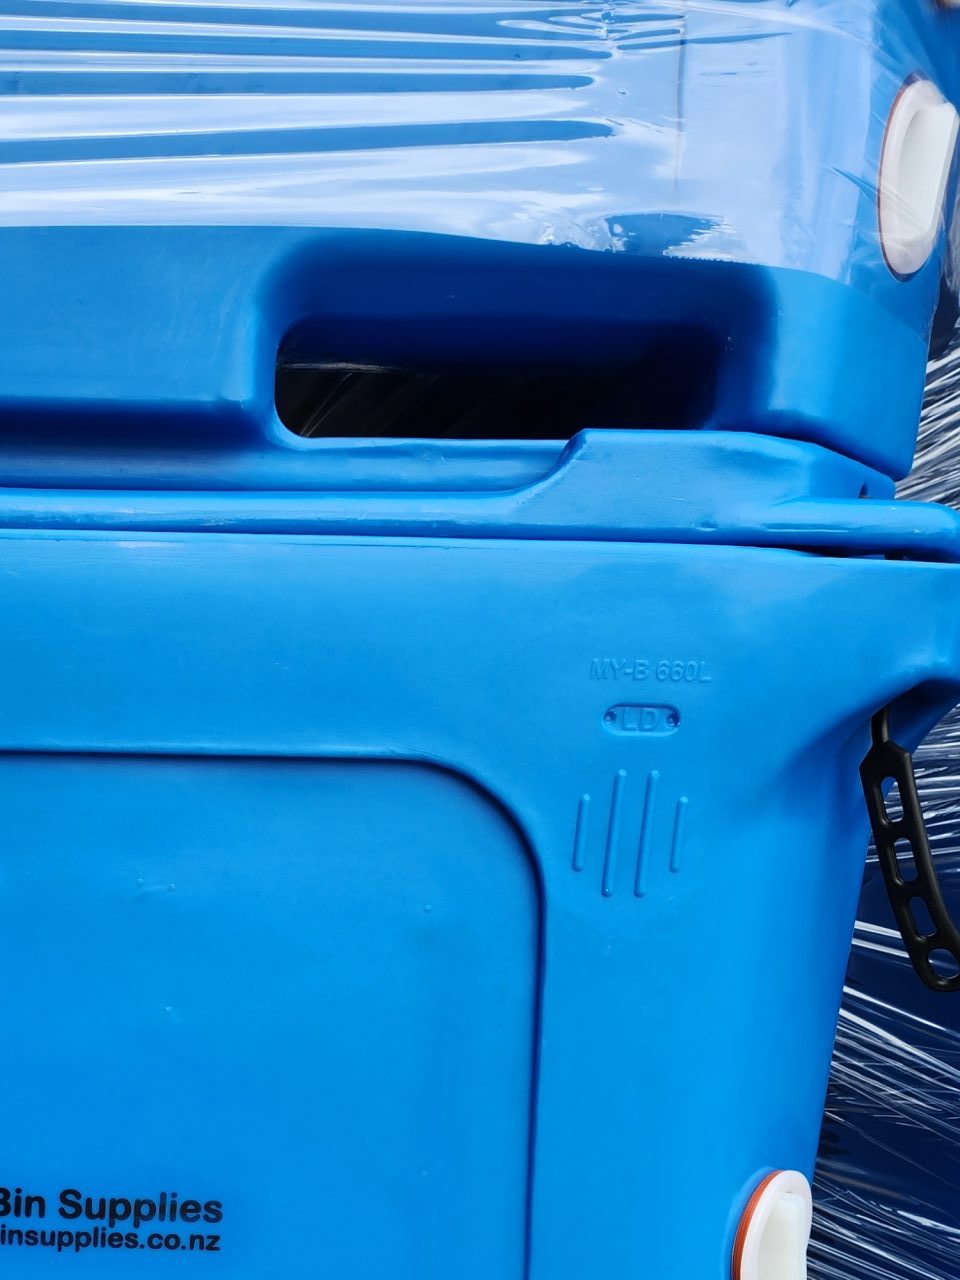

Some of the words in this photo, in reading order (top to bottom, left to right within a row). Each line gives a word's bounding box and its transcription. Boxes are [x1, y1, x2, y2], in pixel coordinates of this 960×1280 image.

[590, 657, 651, 681] MY-B
[655, 658, 713, 684] 660L
[58, 1188, 224, 1229] Supplies
